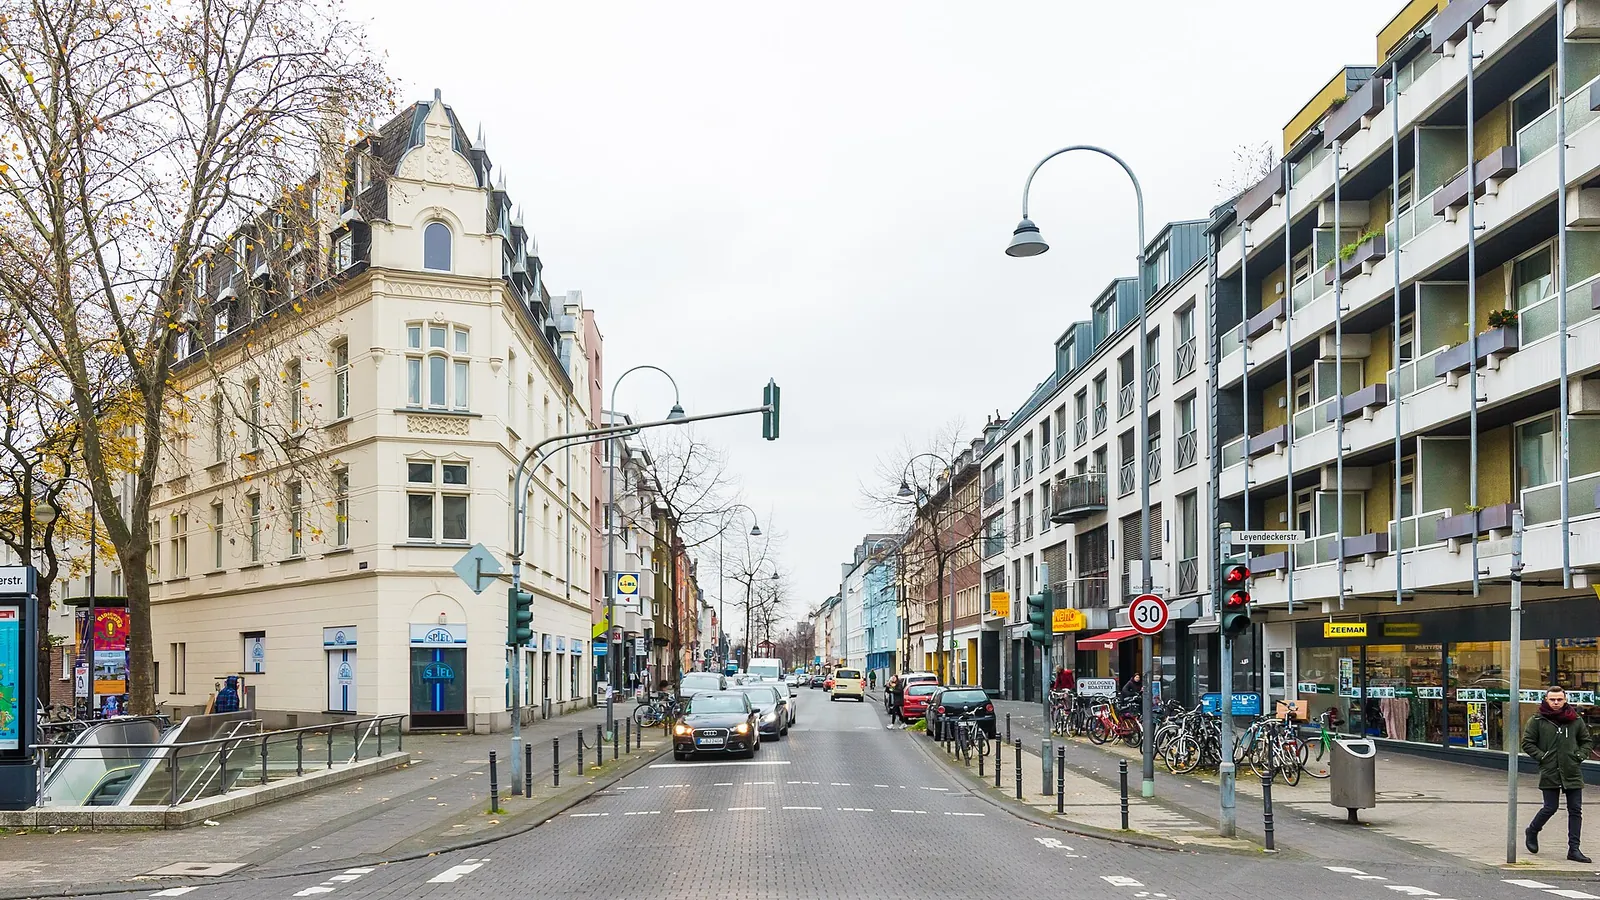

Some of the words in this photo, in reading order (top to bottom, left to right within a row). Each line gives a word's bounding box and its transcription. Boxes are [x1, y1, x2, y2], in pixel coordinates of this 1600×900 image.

[1239, 532, 1299, 542] Leyendeckerstr.
[0, 576, 23, 585] erstr.
[1137, 605, 1160, 622] 30
[1330, 626, 1365, 634] ZEEMAN
[425, 664, 452, 678] SIEL
